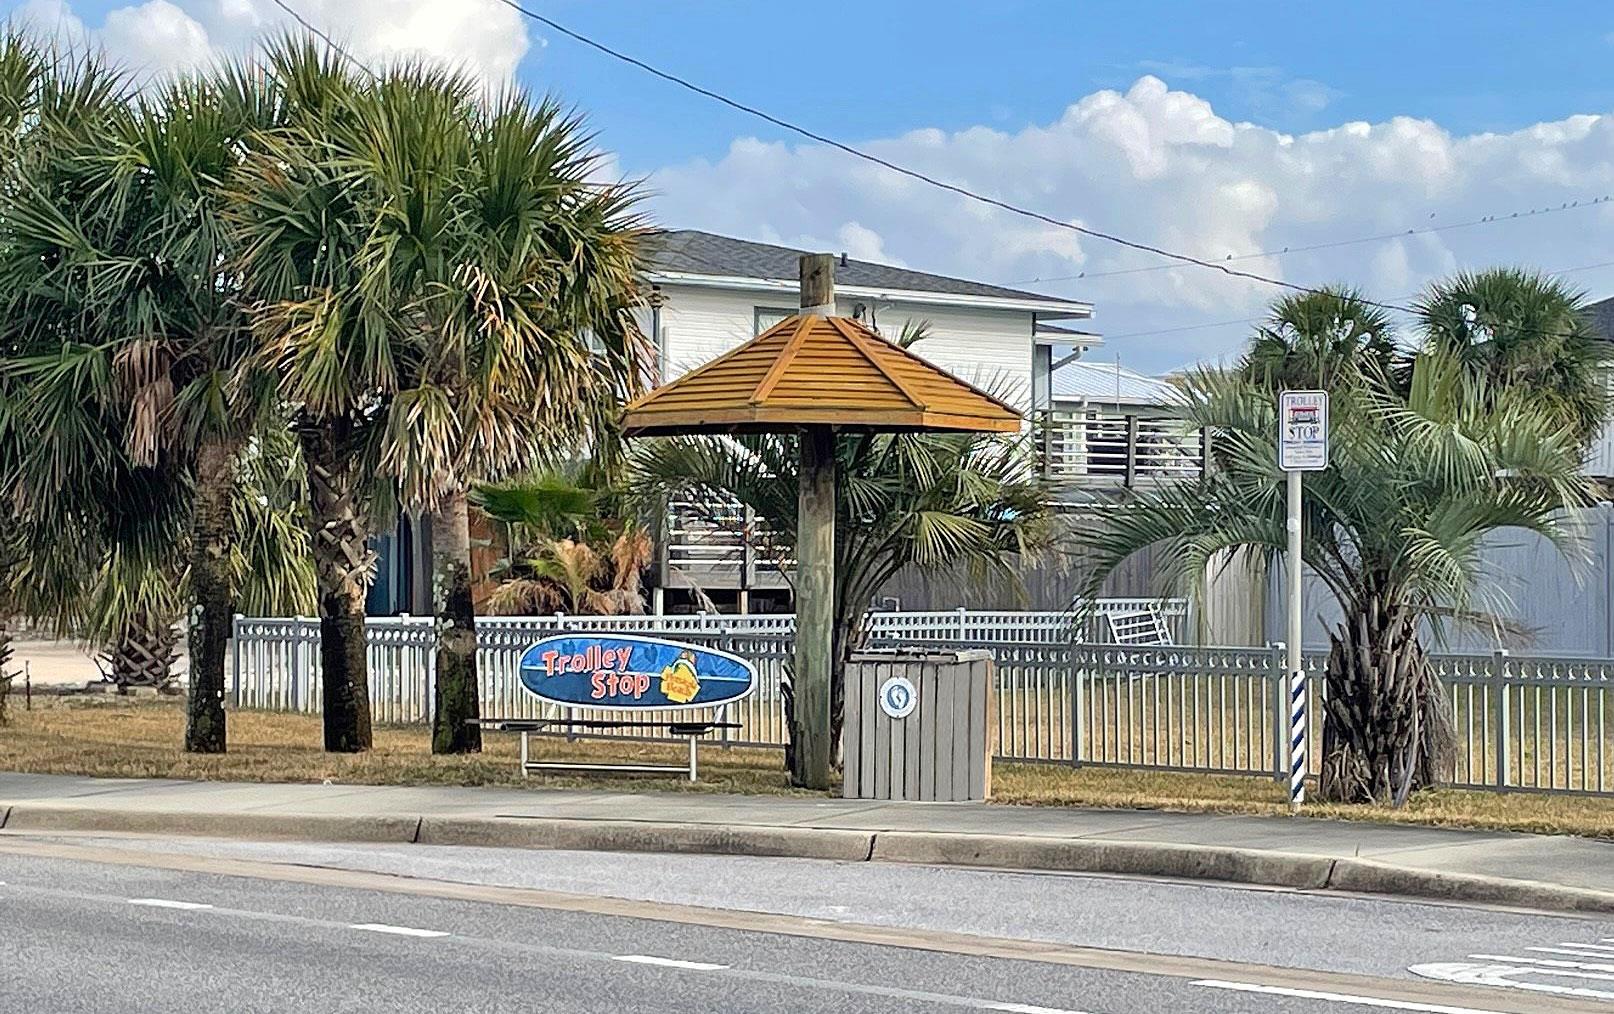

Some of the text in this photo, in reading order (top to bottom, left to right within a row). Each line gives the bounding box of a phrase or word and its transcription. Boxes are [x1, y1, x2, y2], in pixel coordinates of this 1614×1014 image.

[1286, 396, 1324, 406] TROLLEY
[1289, 426, 1320, 440] STOP
[542, 645, 632, 676] Trolley
[591, 671, 650, 699] Stop
